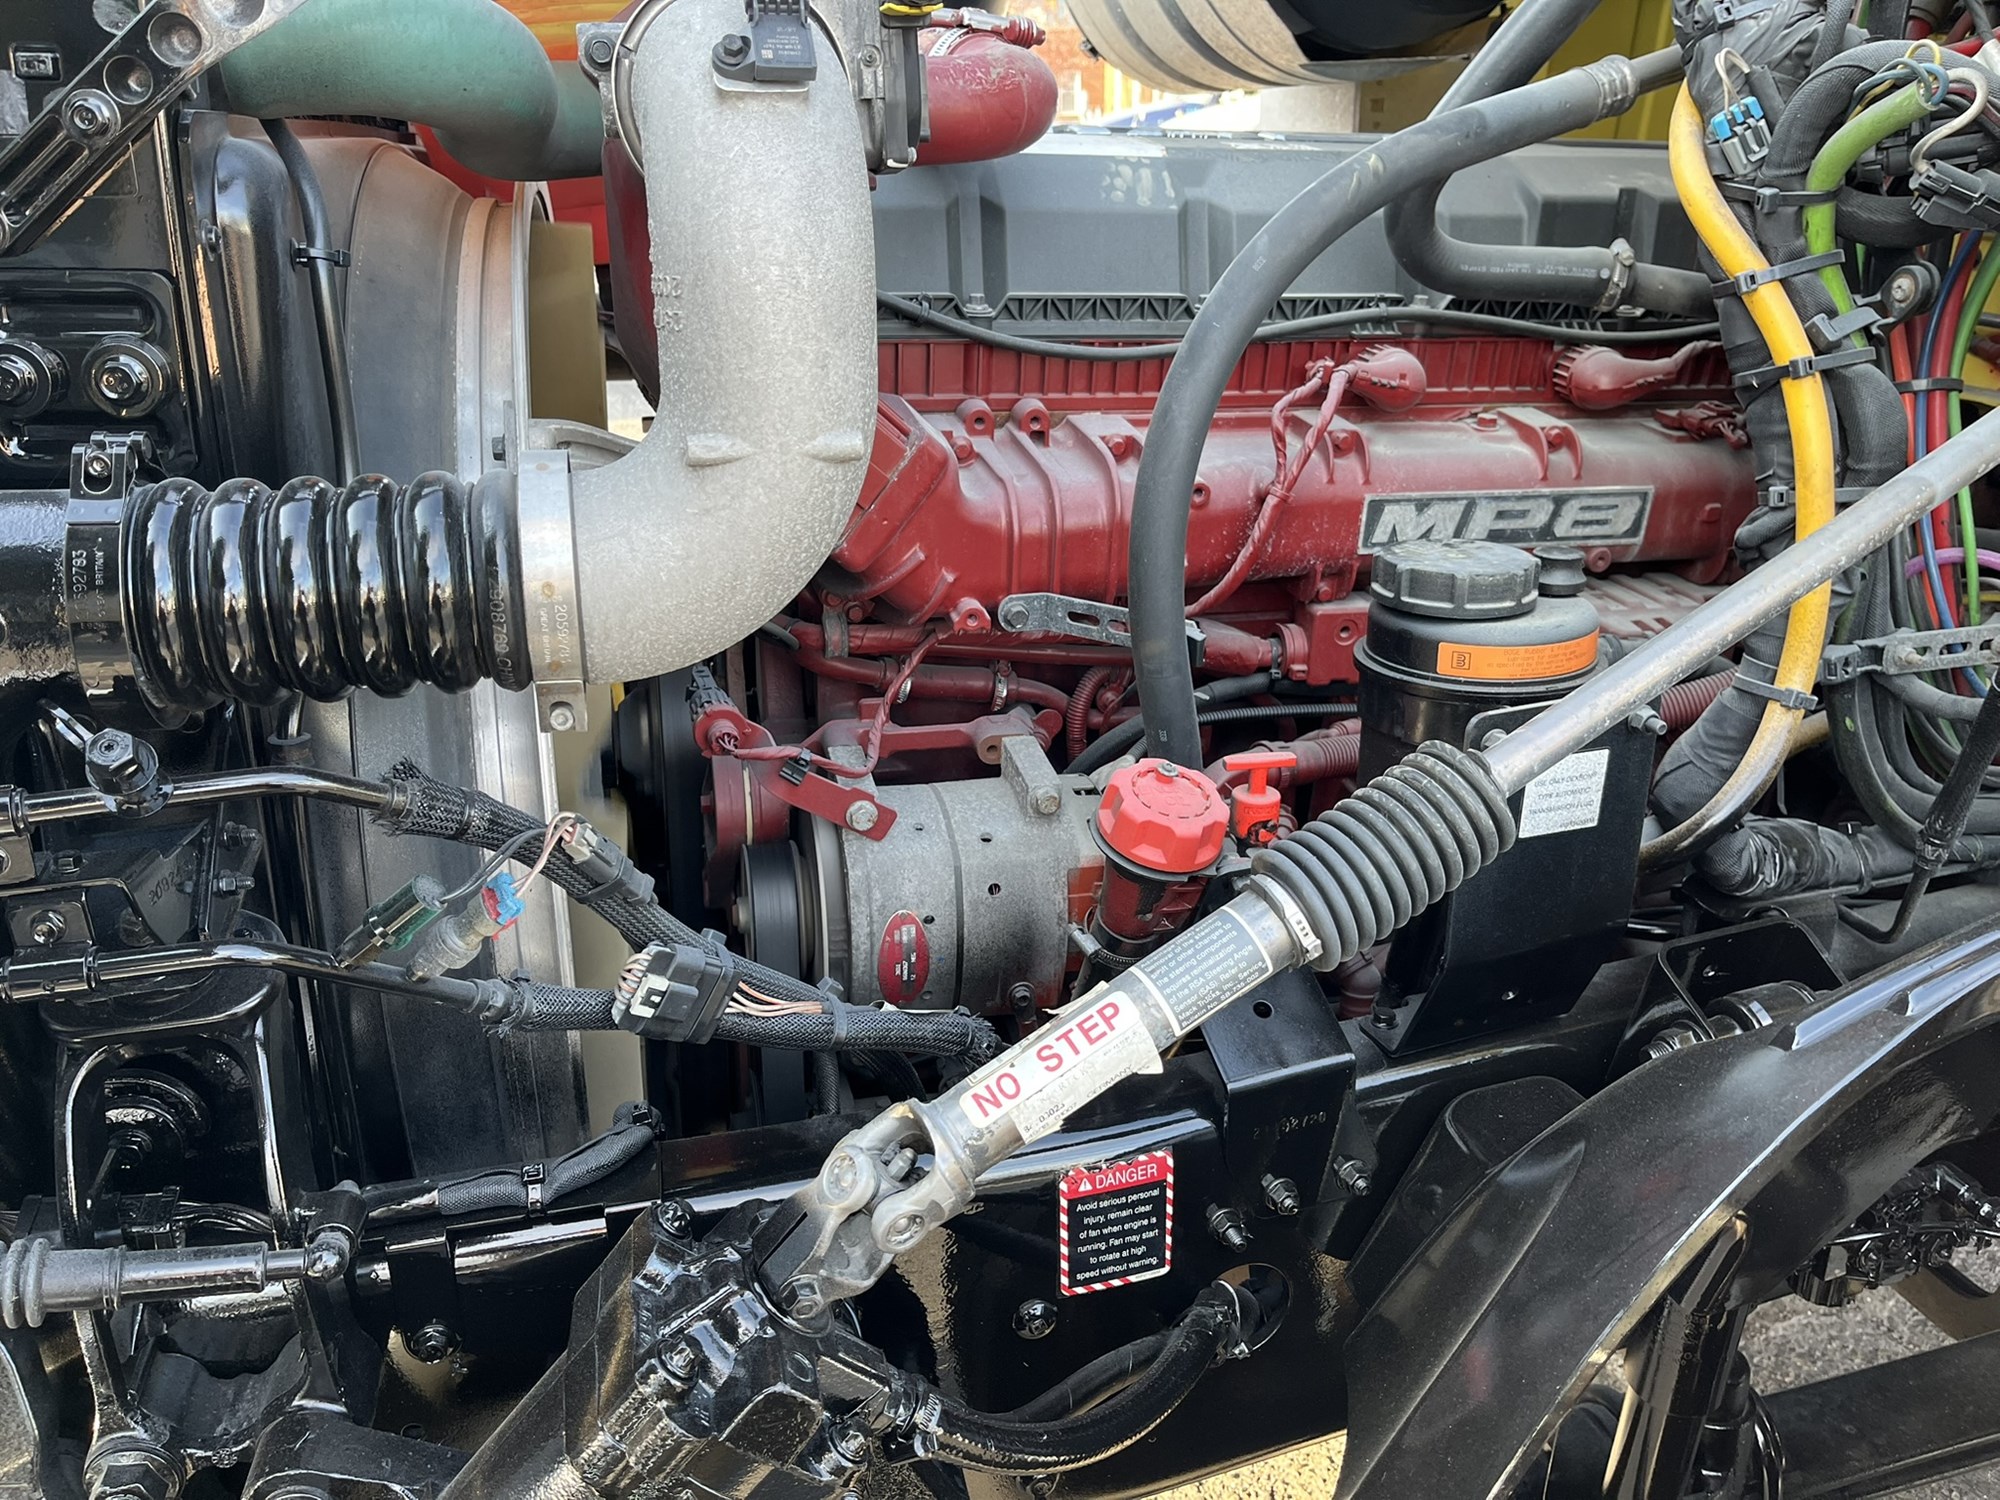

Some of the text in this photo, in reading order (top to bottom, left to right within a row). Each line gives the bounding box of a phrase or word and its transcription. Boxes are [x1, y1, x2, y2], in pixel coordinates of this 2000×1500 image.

[1370, 496, 1645, 544] MP8
[1176, 947, 1194, 961] other
[1194, 928, 1223, 950] changes
[1223, 922, 1231, 930] to
[1182, 938, 1194, 947] the
[1156, 930, 1238, 986] the steering components
[1162, 943, 1236, 995] requires reinitialization
[1168, 944, 1253, 1003] of the RSA Steering Angle
[1173, 993, 1198, 1012] Sensor
[1220, 966, 1239, 981] Refer
[1177, 1005, 1197, 1020] Mack
[1237, 960, 1262, 979] Service
[971, 1072, 1022, 1118] NO
[1036, 1002, 1120, 1073] STEP
[1096, 1163, 1158, 1189] DANGER
[1076, 1188, 1160, 1212] Avoid serious personal
[1083, 1204, 1153, 1225] injury, remain clear
[1077, 1229, 1159, 1253] running. Fan may start
[1079, 1216, 1157, 1239] of fan when engine is
[1076, 1270, 1099, 1280] speed
[1101, 1263, 1127, 1275] without
[1128, 1256, 1159, 1269] warning.
[1090, 1245, 1146, 1264] to rotate at high
